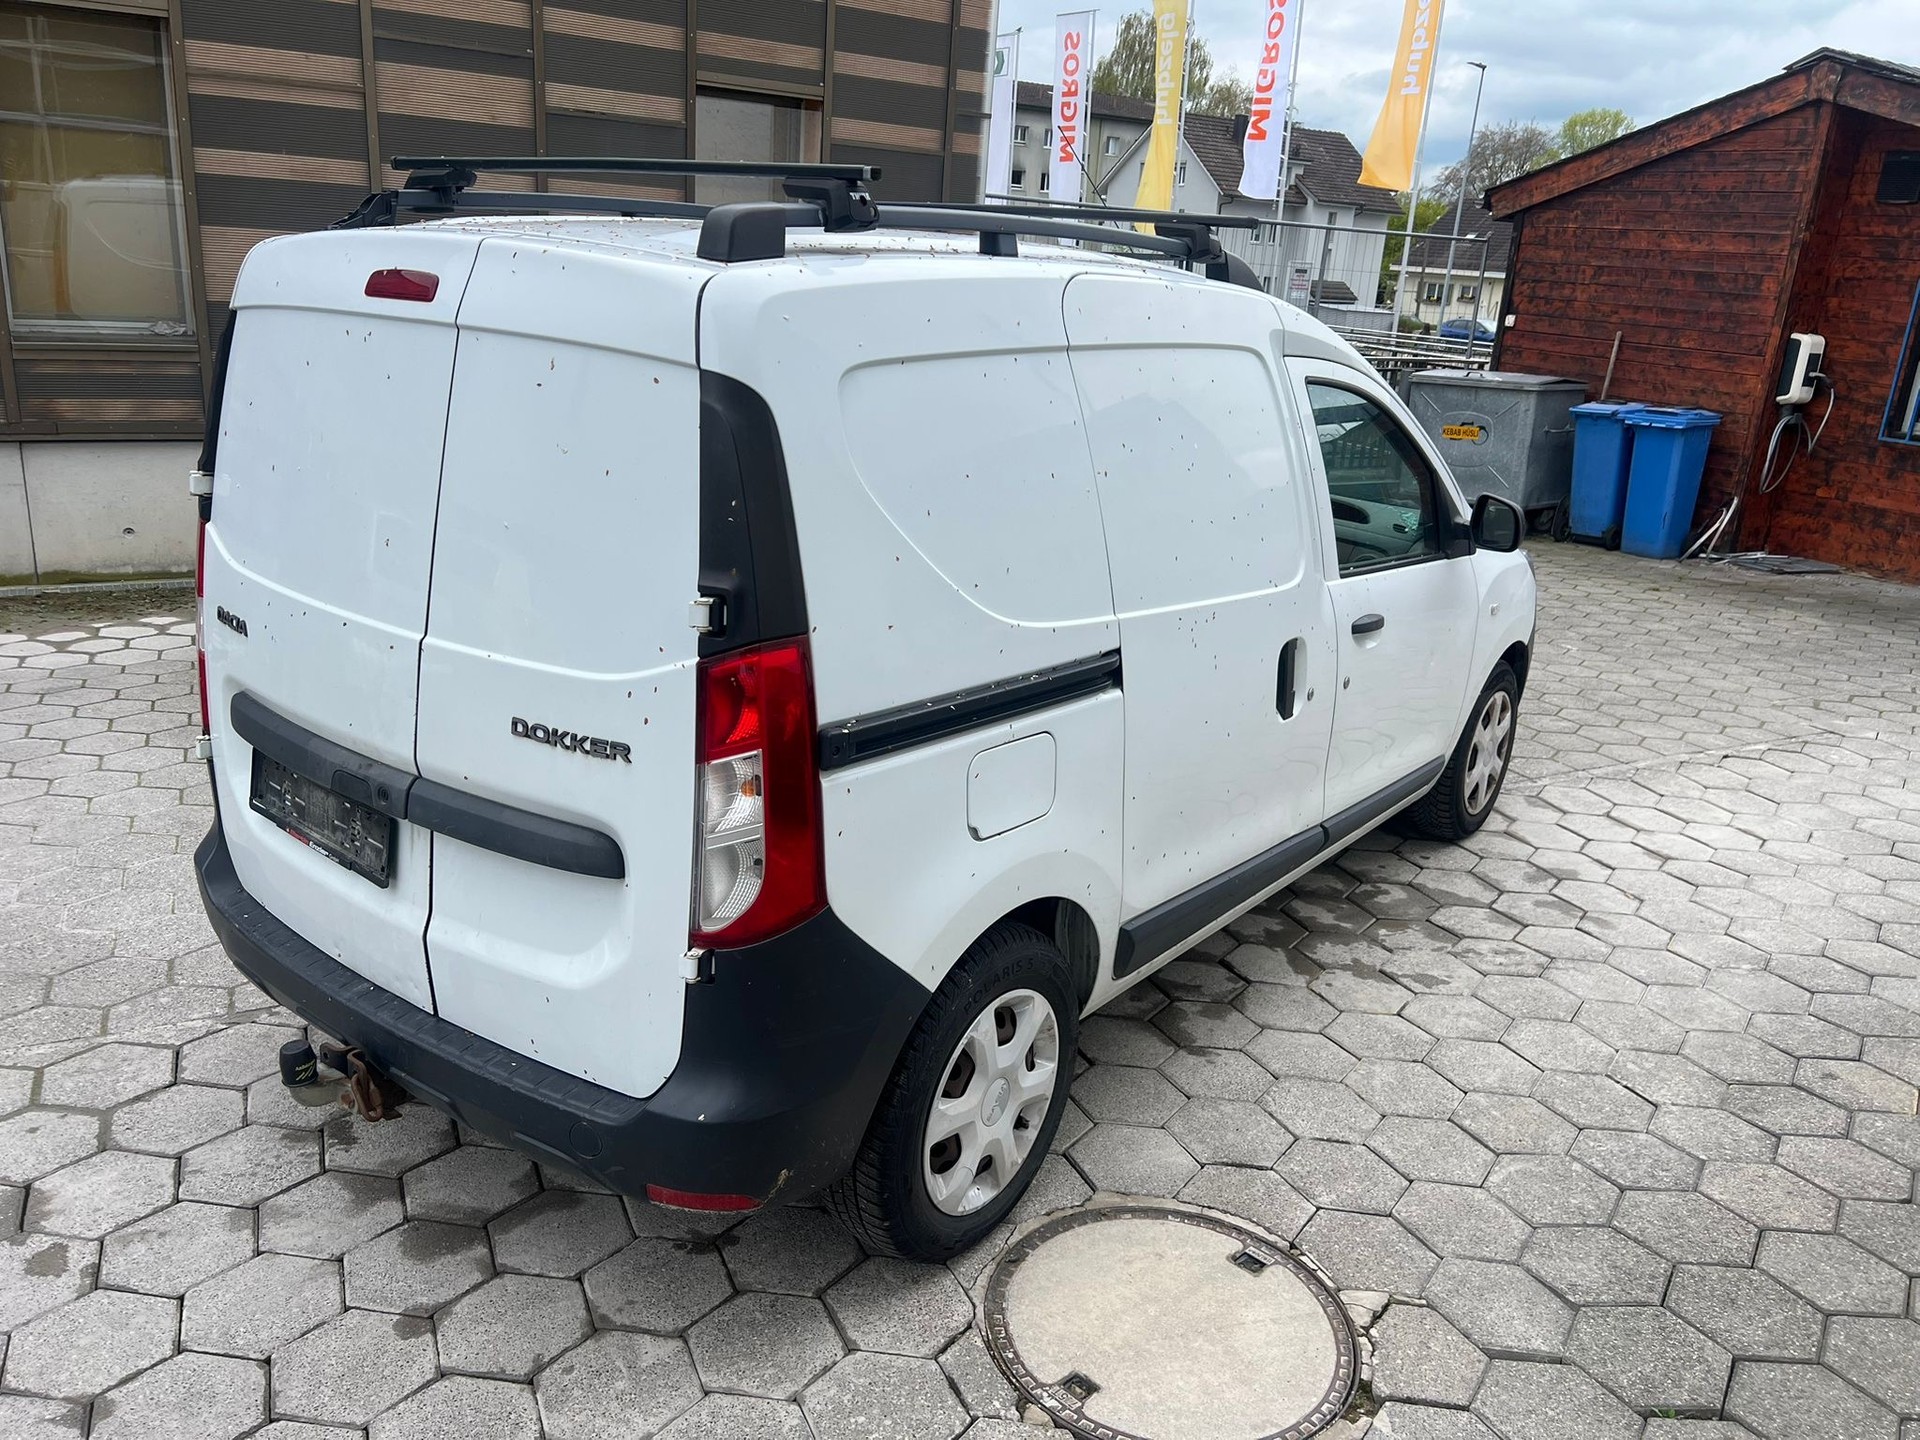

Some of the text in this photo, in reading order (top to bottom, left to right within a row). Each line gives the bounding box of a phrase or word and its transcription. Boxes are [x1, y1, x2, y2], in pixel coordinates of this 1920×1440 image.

[1442, 427, 1461, 437] KEBAB
[217, 605, 248, 638] DACIA
[511, 716, 632, 764] DOKKER
